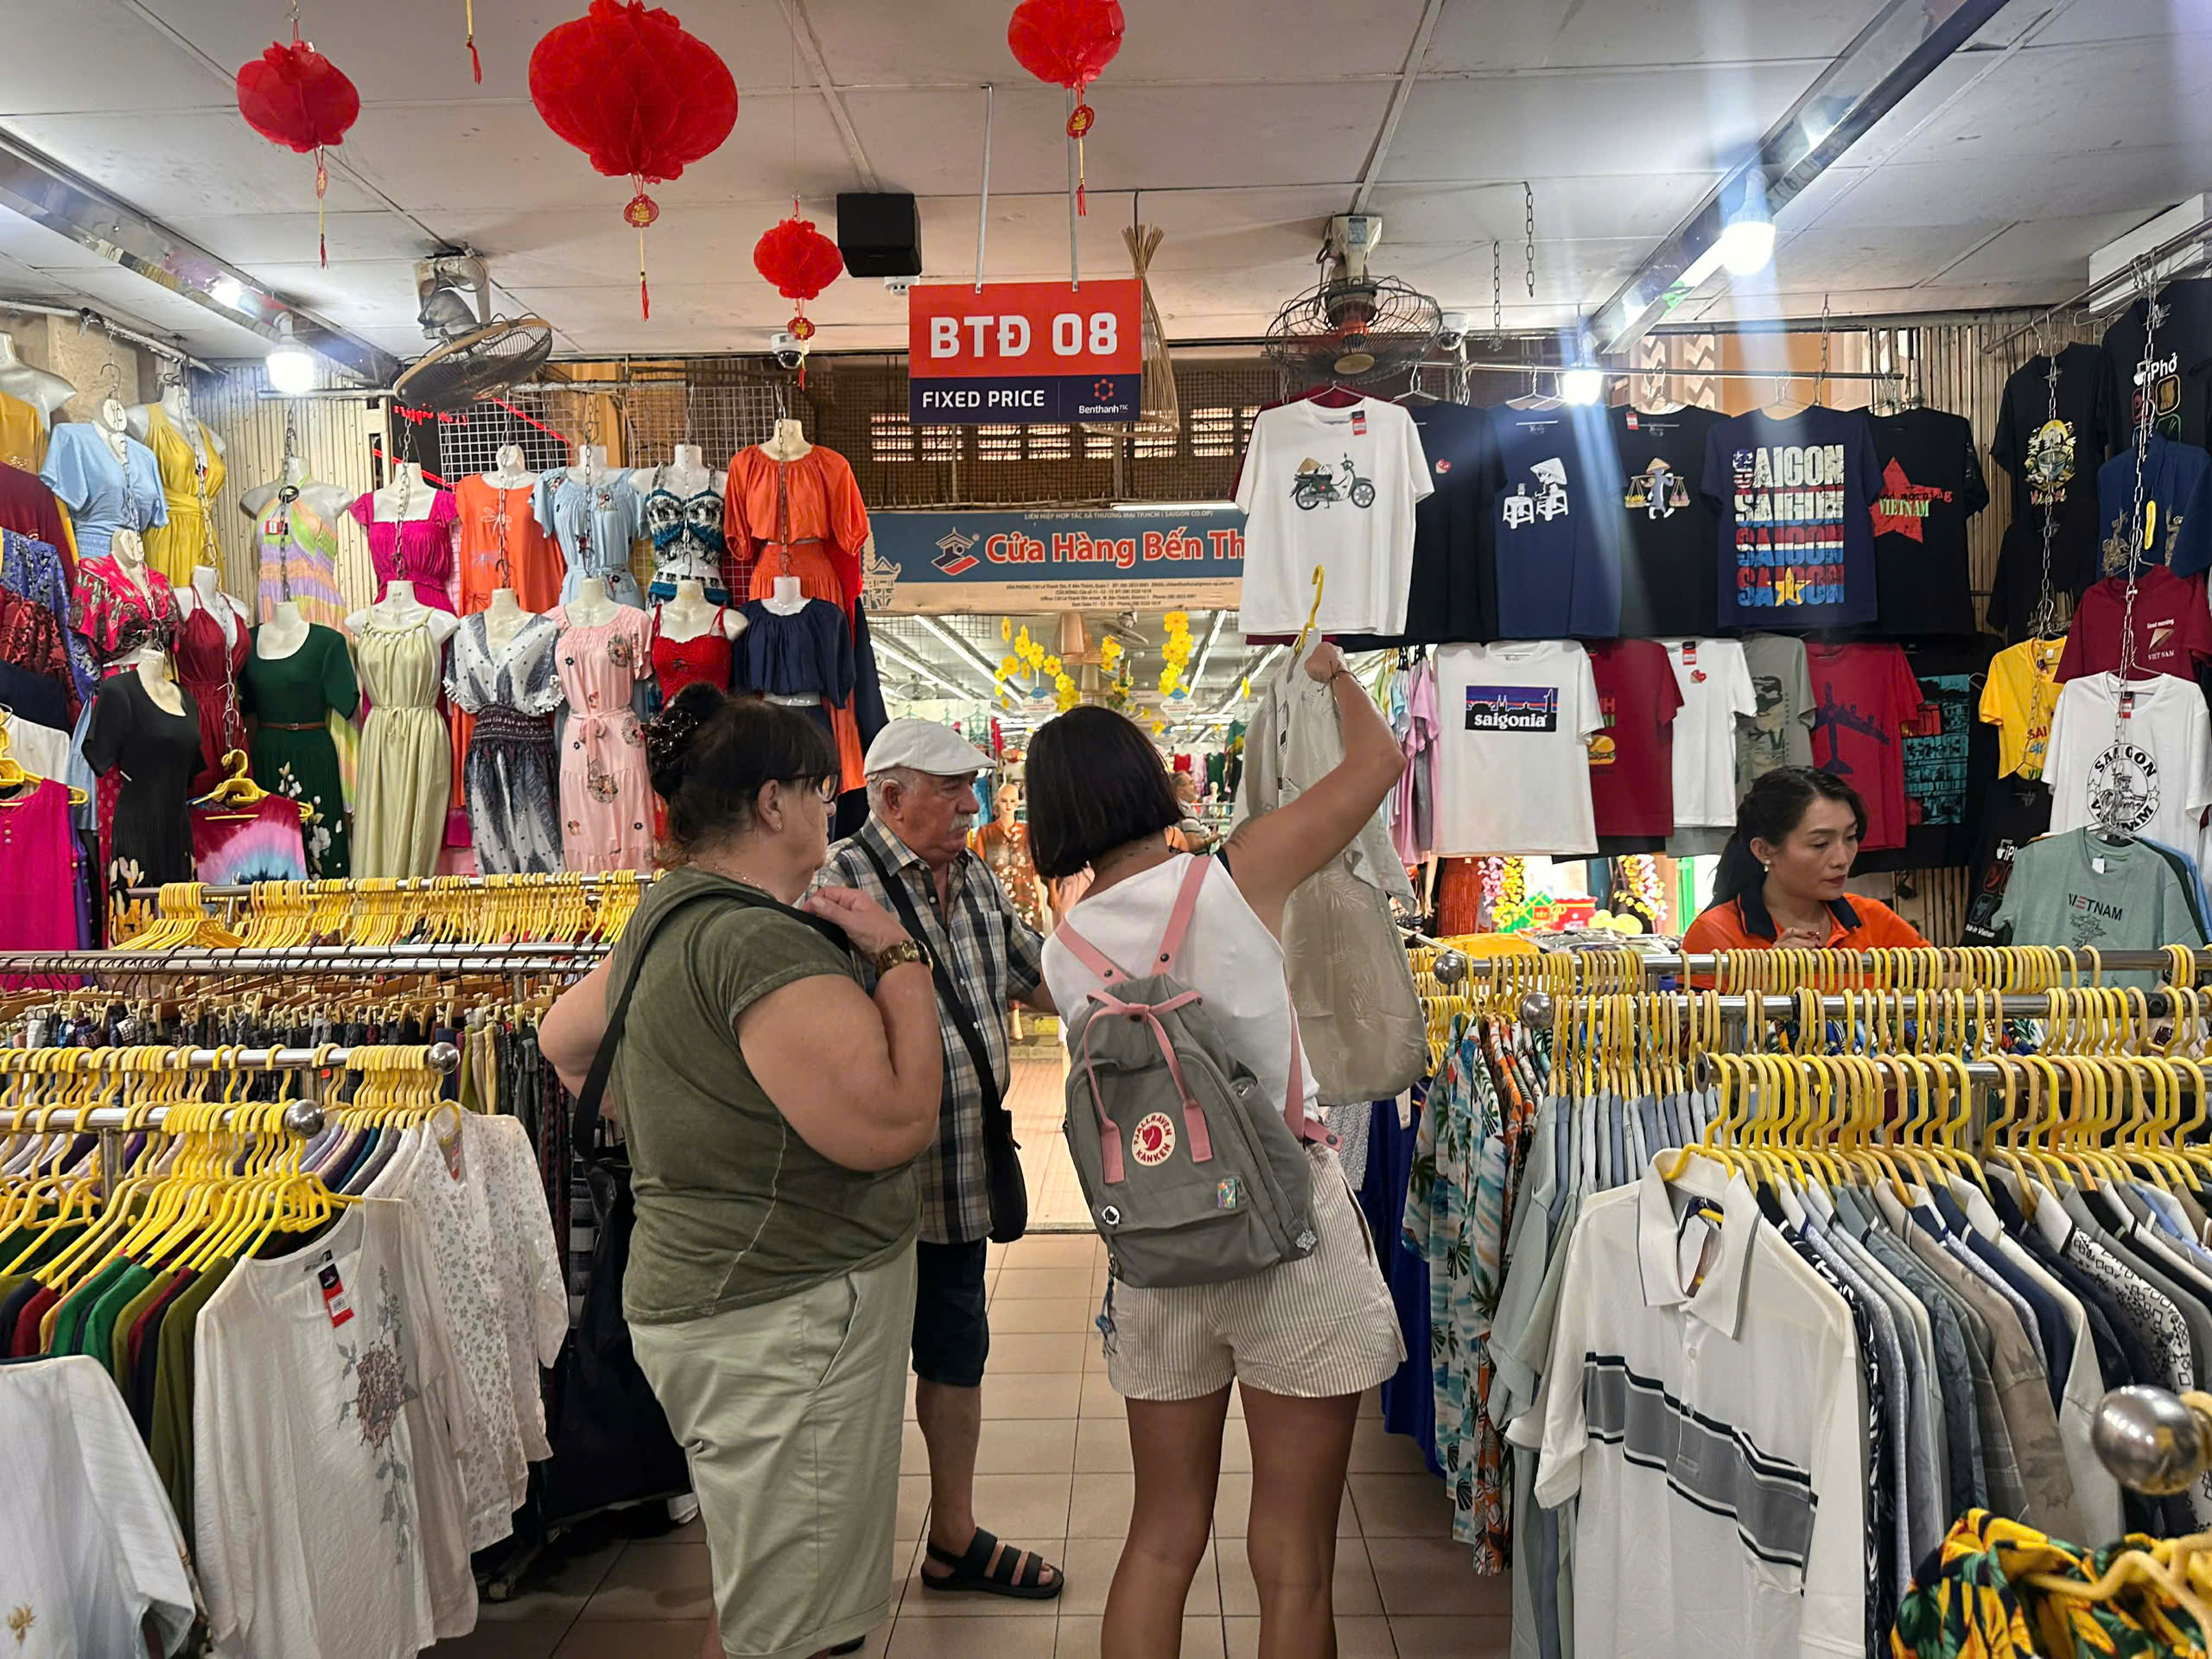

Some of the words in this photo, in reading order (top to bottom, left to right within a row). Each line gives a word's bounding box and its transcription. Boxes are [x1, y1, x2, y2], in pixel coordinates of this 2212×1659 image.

[931, 315, 1031, 359] BTĐ
[1052, 312, 1118, 356] 08
[922, 391, 981, 408] FIXED
[988, 390, 1045, 407] PRICE
[1732, 444, 1845, 489] SAIGON
[1734, 485, 1845, 527] SAIGON
[1879, 499, 1929, 518] VIETNAM
[985, 531, 1046, 563] Cửa
[1052, 531, 1136, 569] Hàng
[1142, 525, 1204, 561] Bến
[1735, 524, 1845, 567] SAIGON
[1474, 713, 1548, 730] saigonia
